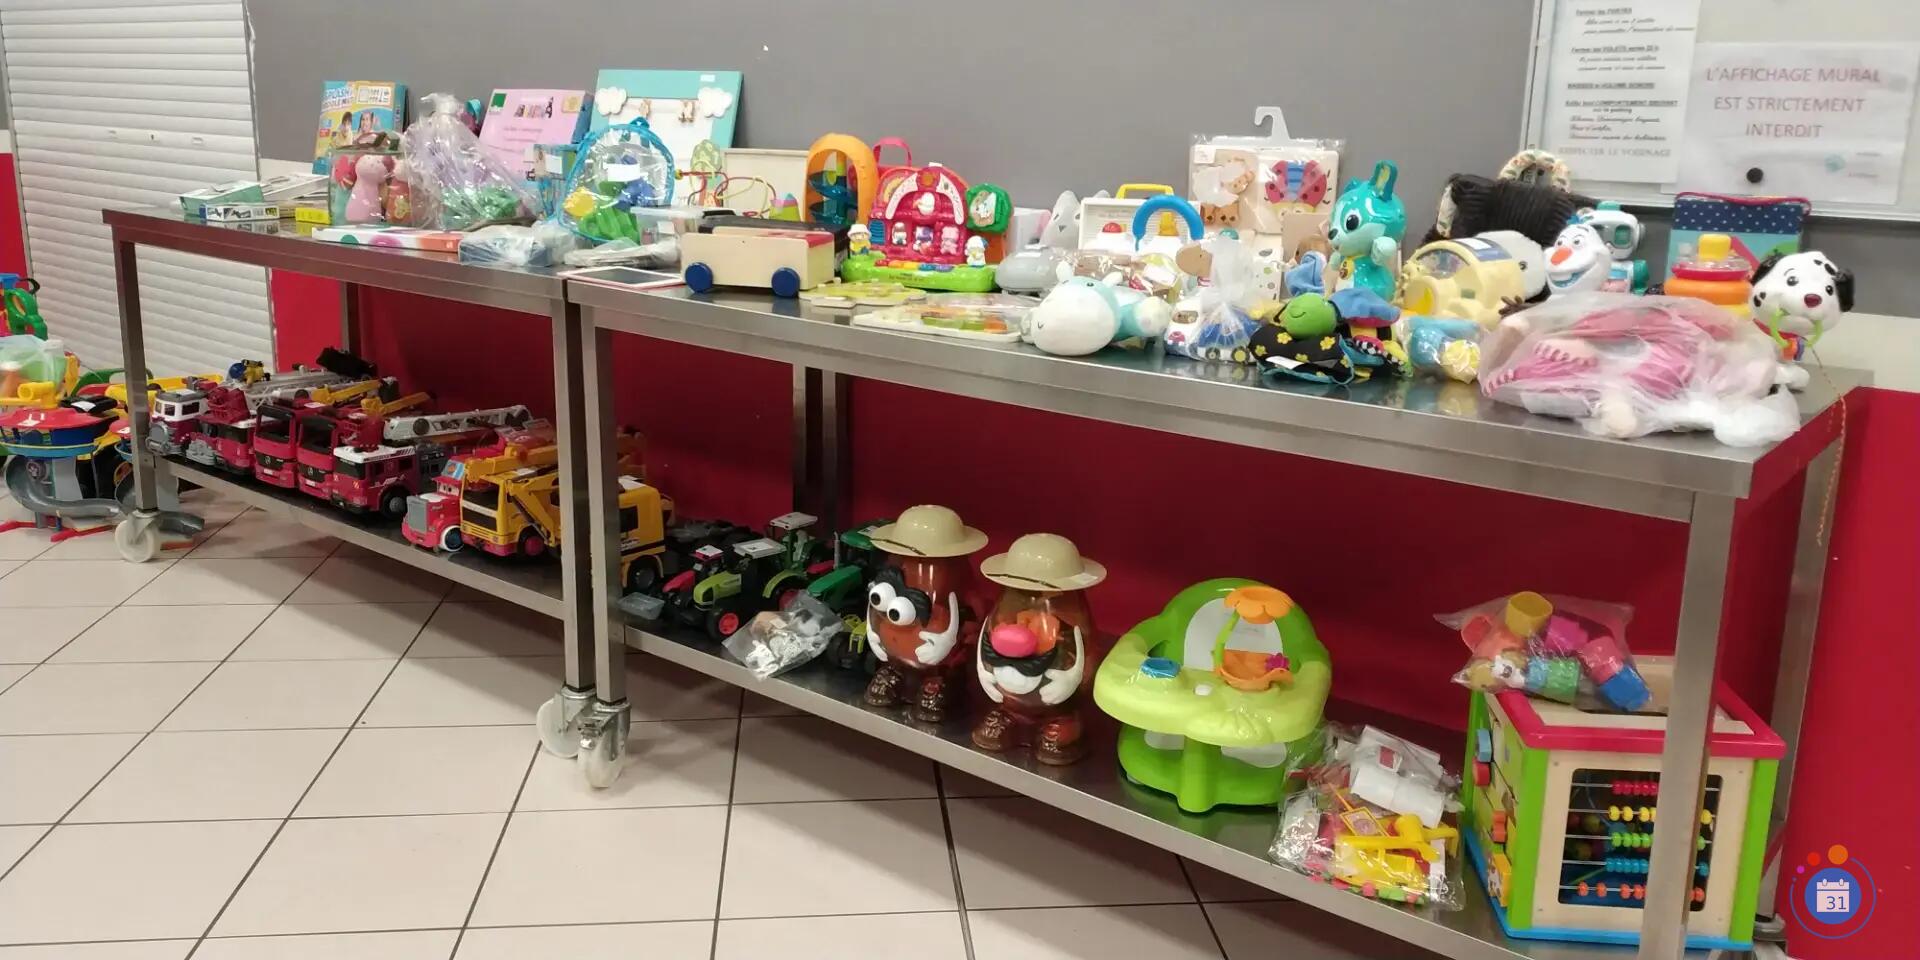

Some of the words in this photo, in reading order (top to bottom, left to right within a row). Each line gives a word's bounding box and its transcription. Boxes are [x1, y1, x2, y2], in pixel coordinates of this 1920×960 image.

[1706, 67, 1813, 82] L'AFFICHAGE
[1818, 68, 1881, 82] MURAL
[1714, 97, 1742, 110] EST
[1746, 97, 1866, 112] STRICTEMENT
[1745, 124, 1824, 138] INTERDIT
